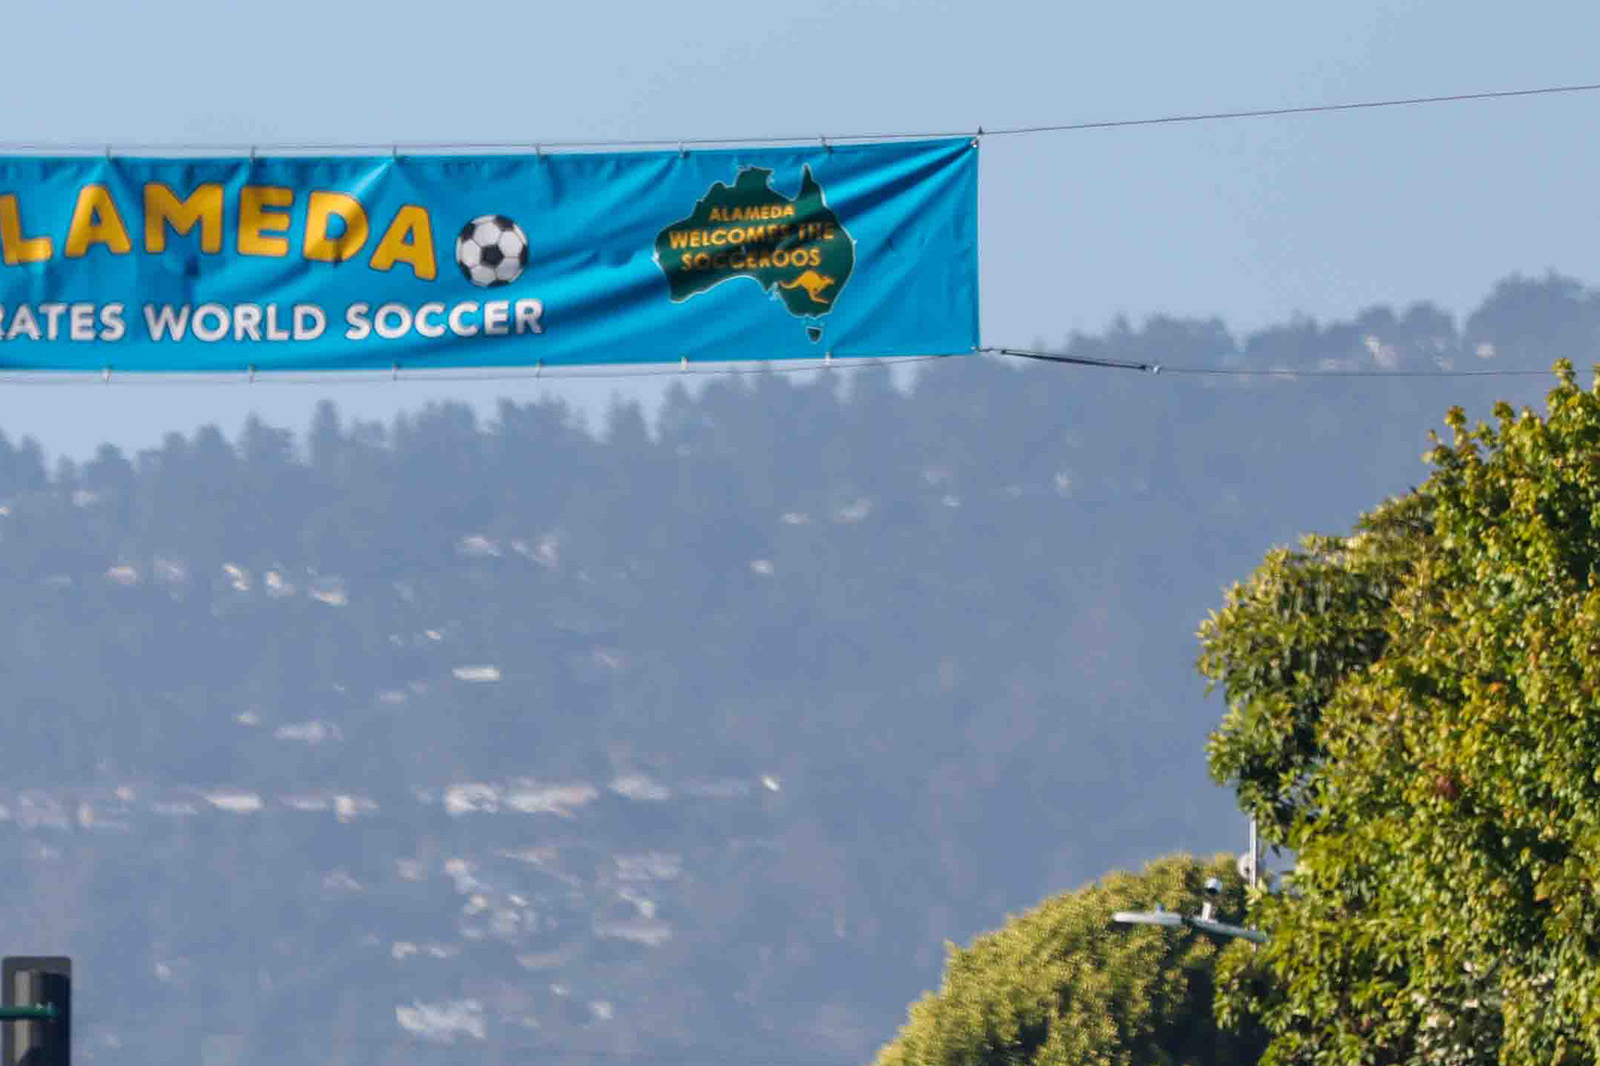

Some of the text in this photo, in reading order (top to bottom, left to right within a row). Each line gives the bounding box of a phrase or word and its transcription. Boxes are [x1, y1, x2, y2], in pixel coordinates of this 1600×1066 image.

[710, 205, 795, 221] ALAMEDA
[671, 222, 833, 248] WELCOMES THE
[682, 249, 821, 271] SOCCEROOS
[144, 302, 326, 342] WORLD
[344, 298, 544, 337] SOCCER
